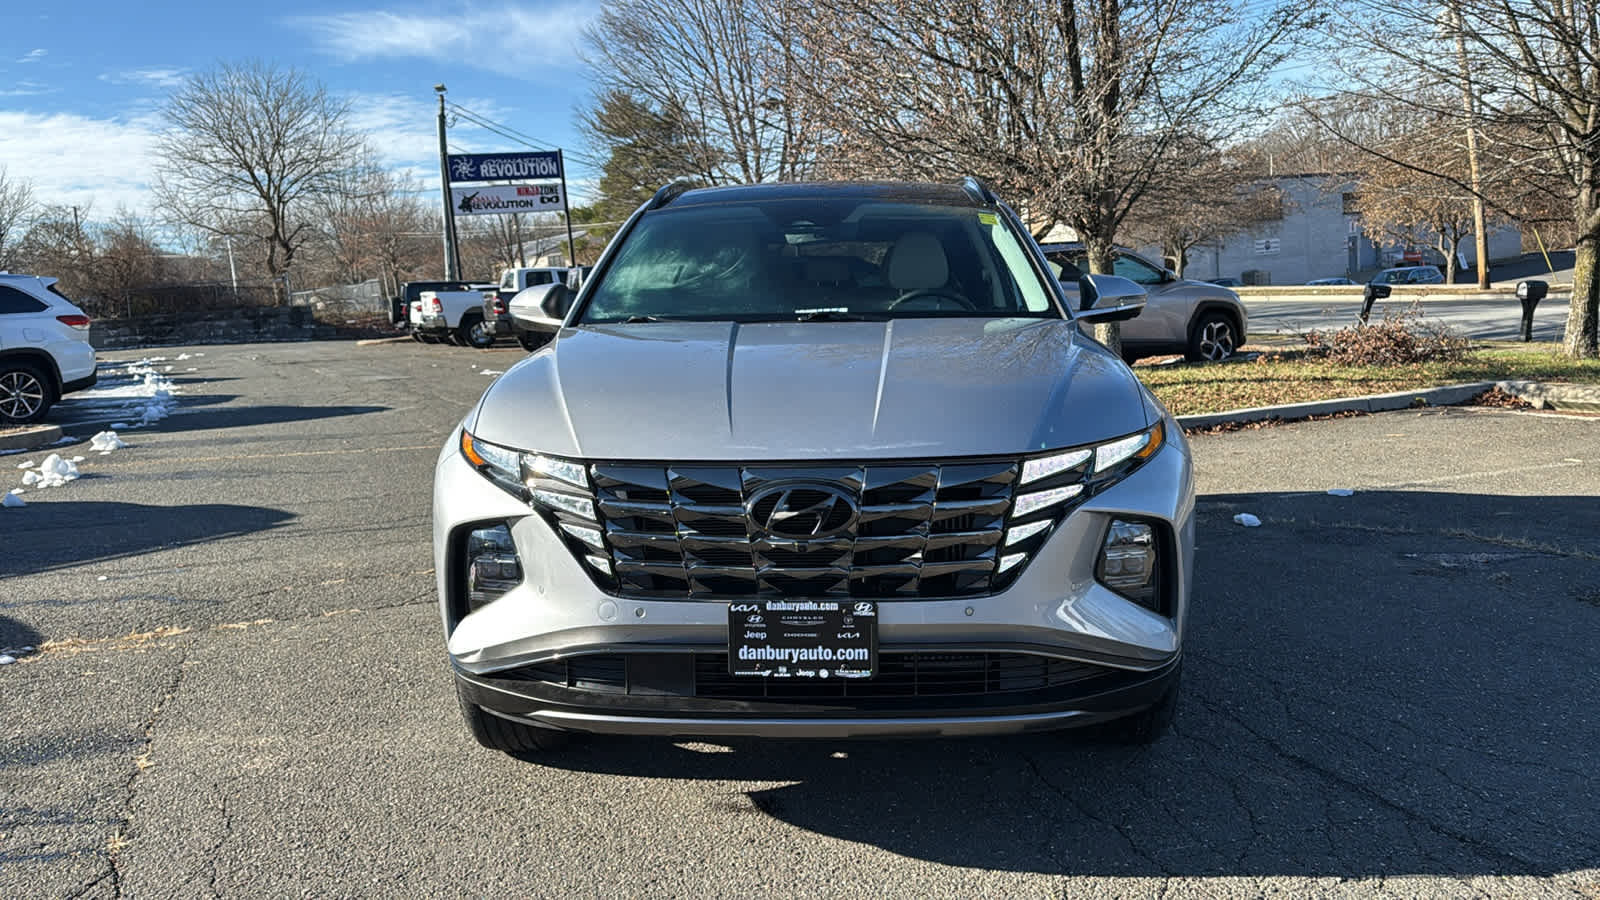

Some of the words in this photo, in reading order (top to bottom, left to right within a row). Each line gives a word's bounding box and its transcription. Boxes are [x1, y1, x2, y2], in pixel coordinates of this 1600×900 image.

[480, 161, 558, 177] REVOLUTION
[766, 600, 839, 612] danburyauto.com
[744, 630, 767, 640] Jeep
[738, 644, 868, 663] danburyauto.com
